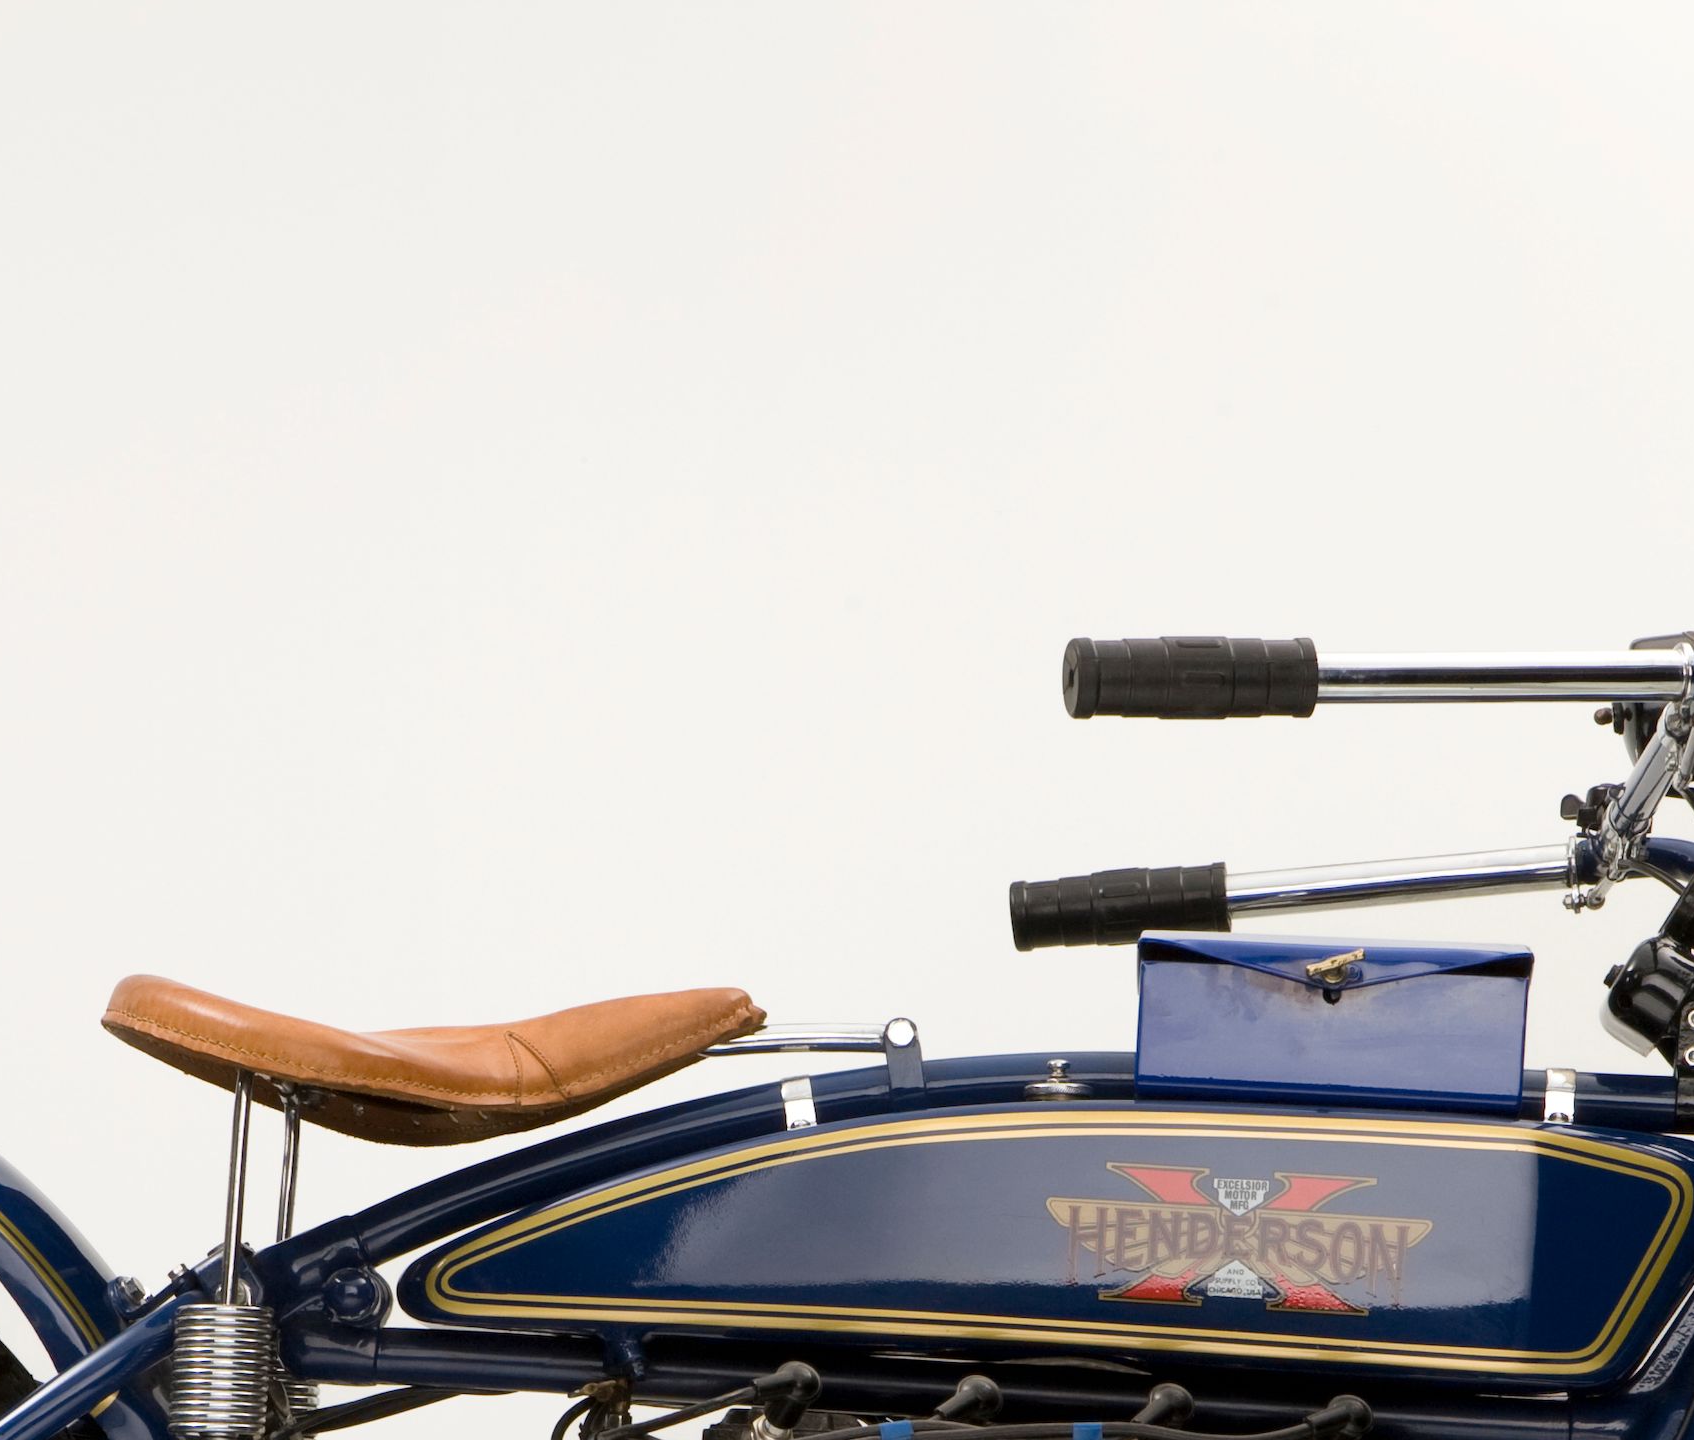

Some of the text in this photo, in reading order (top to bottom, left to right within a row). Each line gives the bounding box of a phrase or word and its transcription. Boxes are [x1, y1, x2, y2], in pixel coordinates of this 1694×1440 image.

[1217, 1179, 1268, 1192] EXCELSIOR
[1224, 1190, 1257, 1201] MOTOR
[1068, 1205, 1410, 1306] HENDERSON
